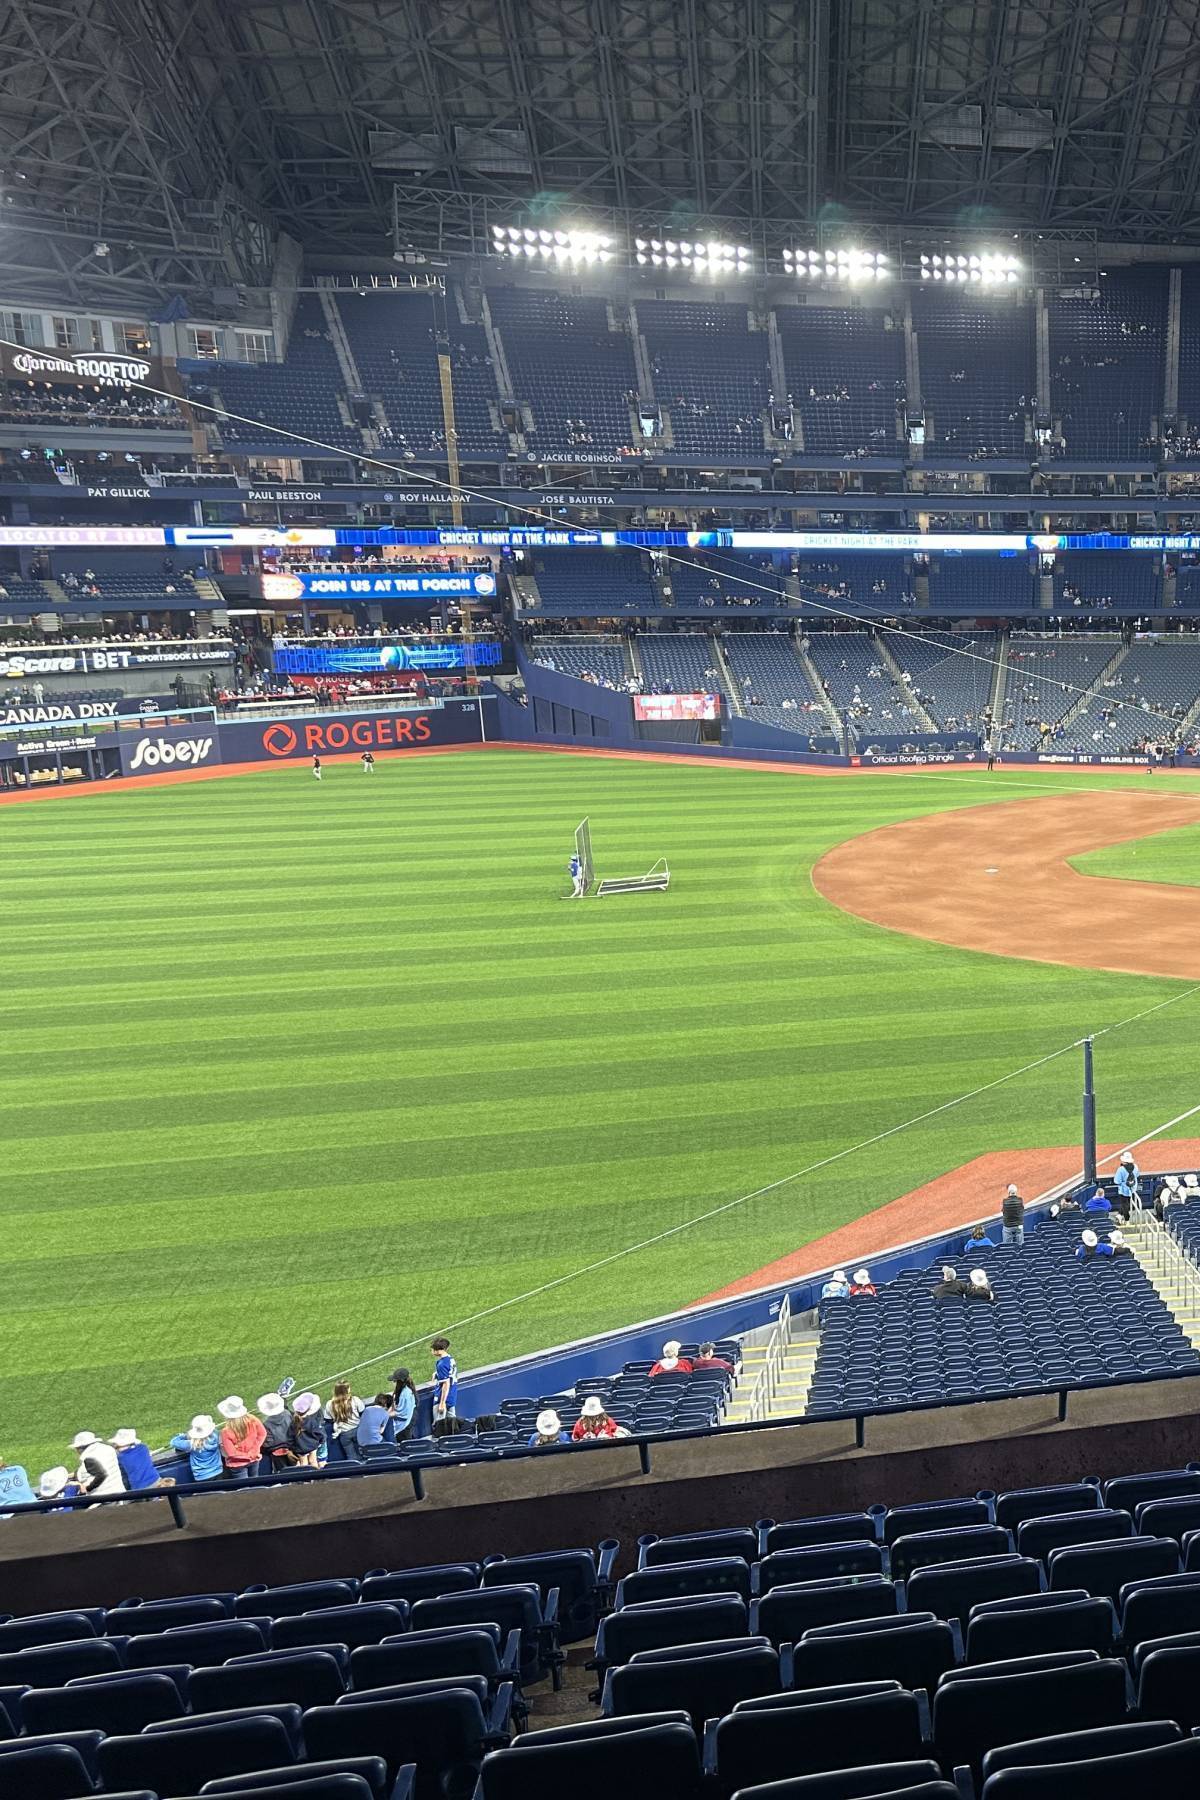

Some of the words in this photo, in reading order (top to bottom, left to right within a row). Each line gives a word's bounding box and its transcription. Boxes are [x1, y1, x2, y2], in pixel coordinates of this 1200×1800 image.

[13, 353, 77, 375] Corona
[76, 359, 150, 380] ROOFTOP
[99, 377, 132, 388] PATIO
[541, 453, 572, 462] JACKIE
[575, 454, 622, 463] ROBINSON
[87, 487, 108, 497] PAT
[110, 488, 150, 498] GILLICK
[248, 492, 274, 500] PAUL
[276, 492, 321, 501] BEESTON
[400, 494, 419, 502] ROY
[422, 494, 471, 503] HALLADAY
[568, 496, 615, 505] BAUTISTA
[3, 531, 81, 542] LOCATED
[439, 532, 479, 545] CRICKET
[481, 532, 511, 545] NIGHT
[512, 533, 524, 545] AT
[525, 533, 545, 545] THE
[547, 533, 570, 545] PARK
[803, 535, 838, 545] CRICKET
[841, 535, 866, 546] NIGHT
[868, 536, 877, 546] AT
[880, 536, 895, 546] THE
[897, 537, 919, 546] PARK
[1130, 536, 1163, 548] CRICKET
[1165, 537, 1190, 548] NIGHT
[1191, 537, 1200, 548] AT
[310, 580, 347, 592] JOIN
[351, 580, 371, 592] US
[374, 580, 392, 591] AT
[394, 580, 419, 591] THE
[422, 578, 471, 591] PORCH!
[93, 652, 131, 668] BET
[137, 653, 192, 663] SPORTSBOOK
[193, 652, 198, 660] &
[200, 651, 229, 659] CASINO
[80, 702, 119, 717] DRY.
[461, 704, 475, 712] 328
[305, 716, 431, 750] ROGERS
[17, 742, 44, 751] Active
[131, 738, 213, 769] Sobeys
[872, 756, 898, 764] Official
[900, 755, 927, 763] Roofing
[928, 754, 955, 762] Shingle
